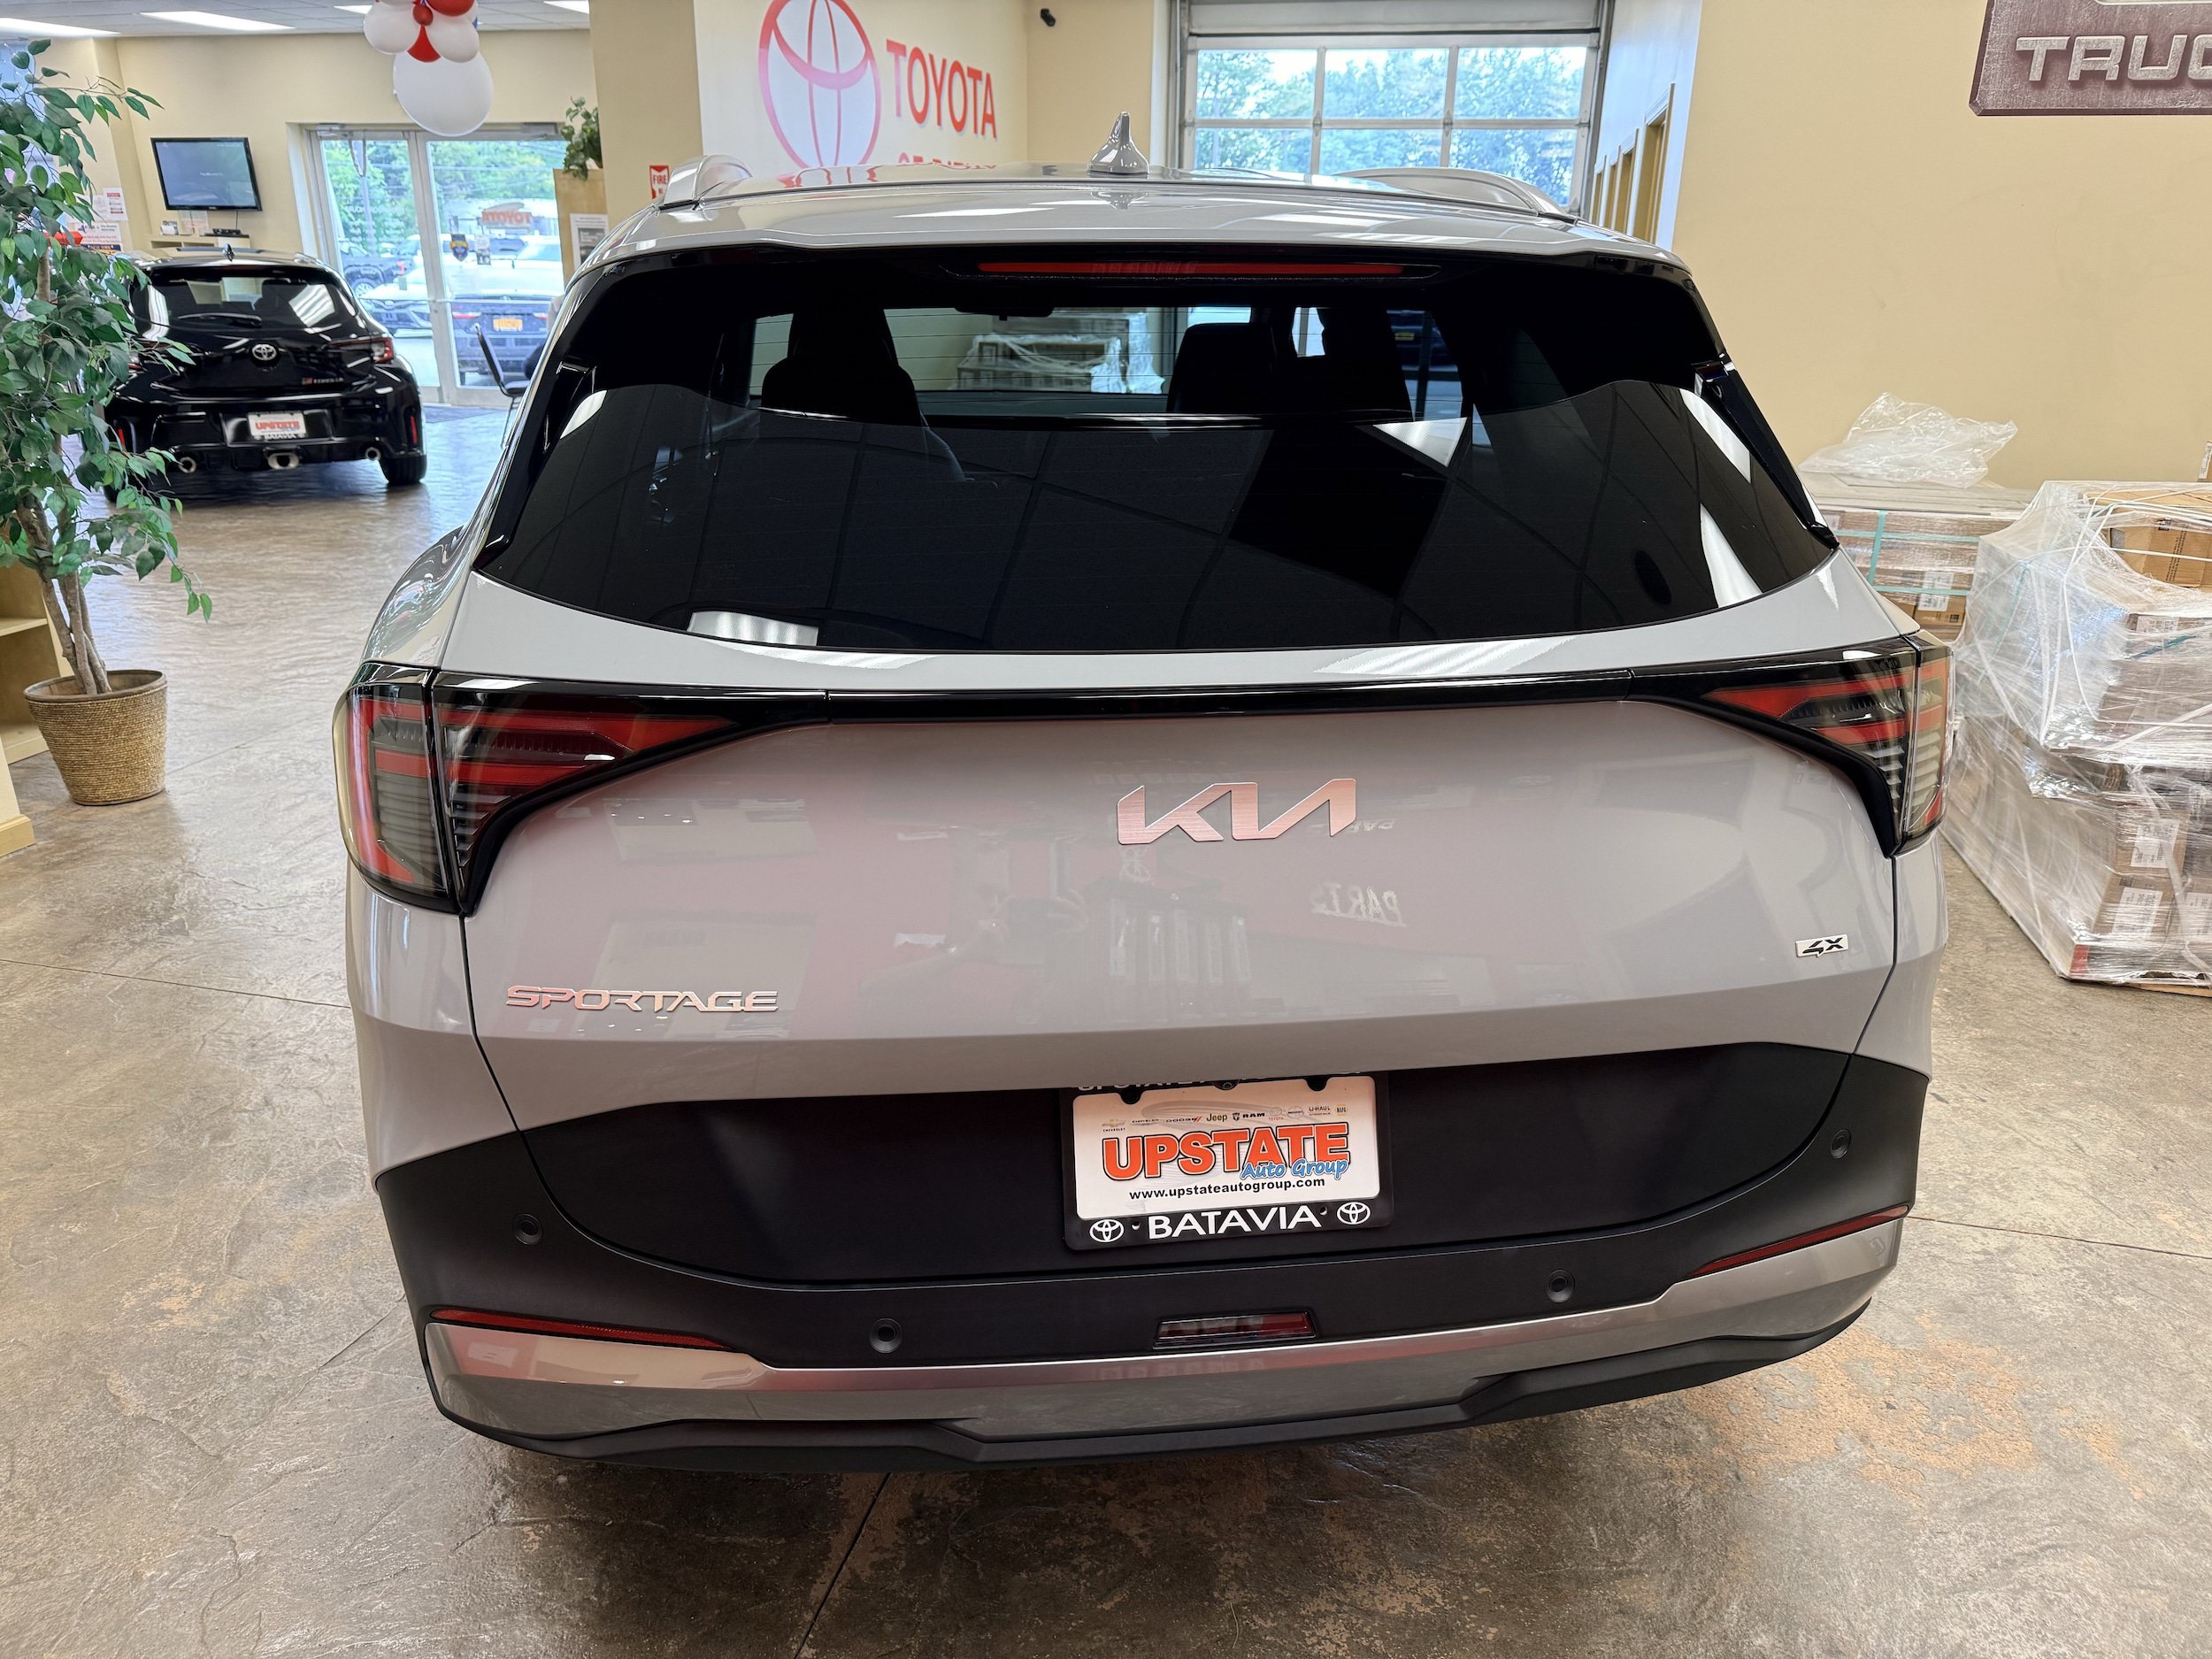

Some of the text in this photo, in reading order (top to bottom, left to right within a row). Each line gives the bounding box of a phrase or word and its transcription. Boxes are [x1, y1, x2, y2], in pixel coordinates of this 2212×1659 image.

[886, 38, 997, 140] TOYOTA
[1118, 779, 1356, 845] KIA
[505, 985, 779, 1013] SPORTAGE
[1206, 1113, 1228, 1123] Jeep
[1102, 1122, 1351, 1180] UPSTATE
[1240, 1158, 1348, 1180] Auto Group
[1129, 1178, 1326, 1201] www.upstateautogroup.com
[1148, 1205, 1322, 1240] BATAVIA
